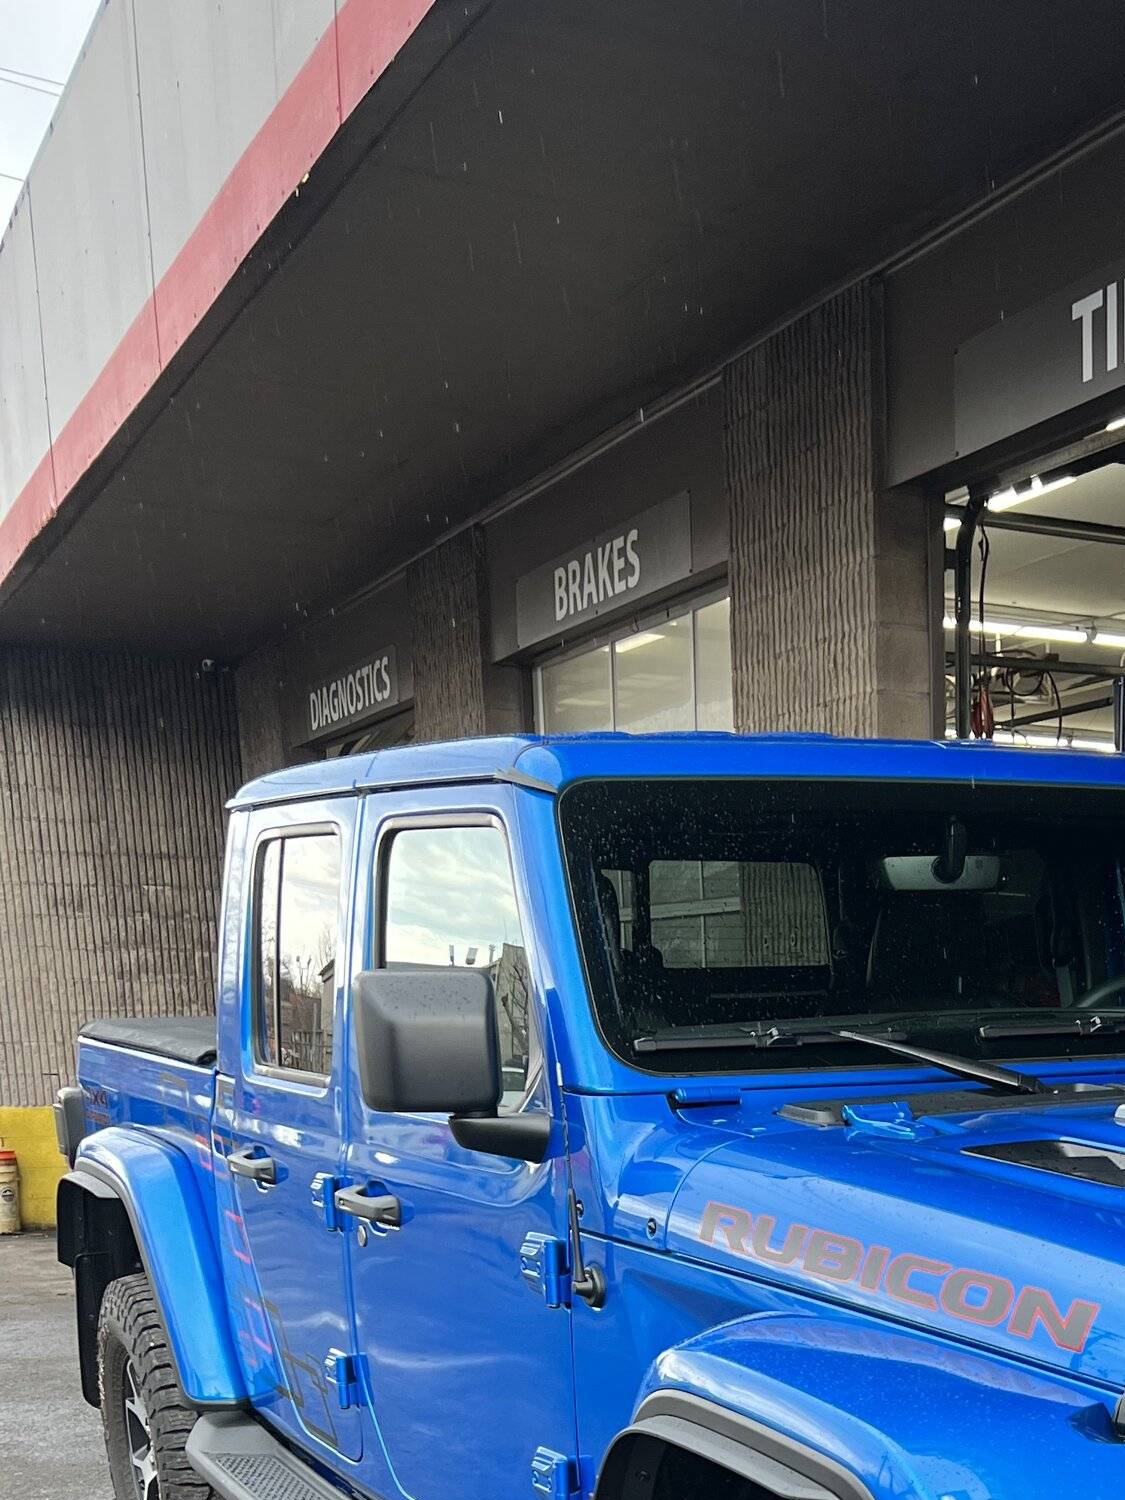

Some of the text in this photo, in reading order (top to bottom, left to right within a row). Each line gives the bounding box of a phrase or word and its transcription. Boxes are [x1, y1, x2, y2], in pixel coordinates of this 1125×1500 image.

[553, 529, 640, 621] BRAKES
[310, 656, 391, 731] DIAGNOSTICS
[699, 1200, 1101, 1354] RUBICON
